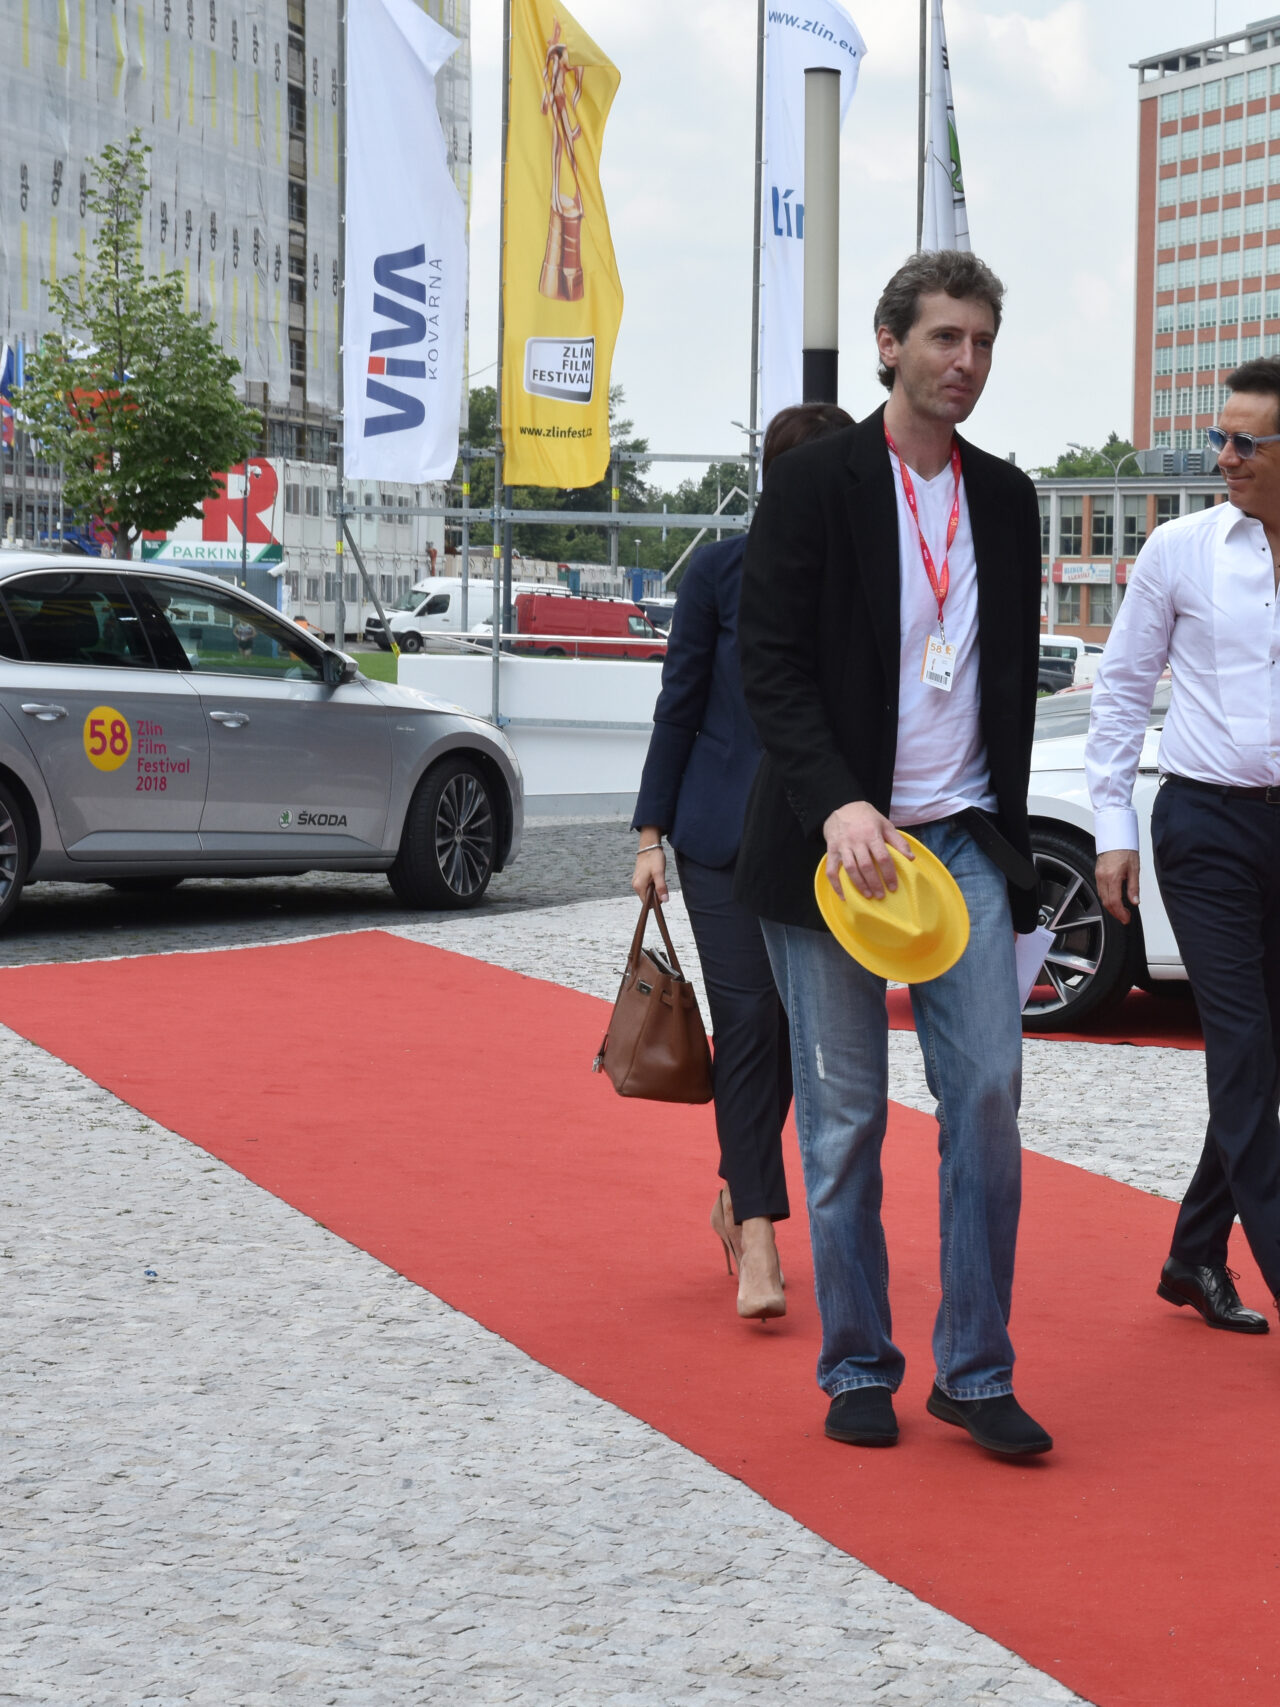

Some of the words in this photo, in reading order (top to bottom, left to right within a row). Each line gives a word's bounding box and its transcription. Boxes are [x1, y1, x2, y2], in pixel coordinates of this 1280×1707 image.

[768, 10, 858, 58] www.zlin.eu
[20, 162, 30, 212] sto
[51, 159, 64, 207] sto
[160, 200, 168, 244] sto
[184, 209, 193, 251] sto
[209, 211, 217, 252] sto
[427, 258, 443, 380] KOVÁRNA
[562, 345, 592, 359] ZLÍN
[562, 359, 591, 372] FILM
[532, 369, 590, 384] FESTIVAL
[173, 546, 252, 560] PARKING
[930, 642, 942, 653] 58
[136, 720, 163, 736] Zlin
[89, 719, 128, 756] 58
[137, 738, 167, 754] Film
[137, 757, 190, 773] Festival
[136, 776, 167, 792] 2018
[297, 811, 347, 827] ŠKODA
